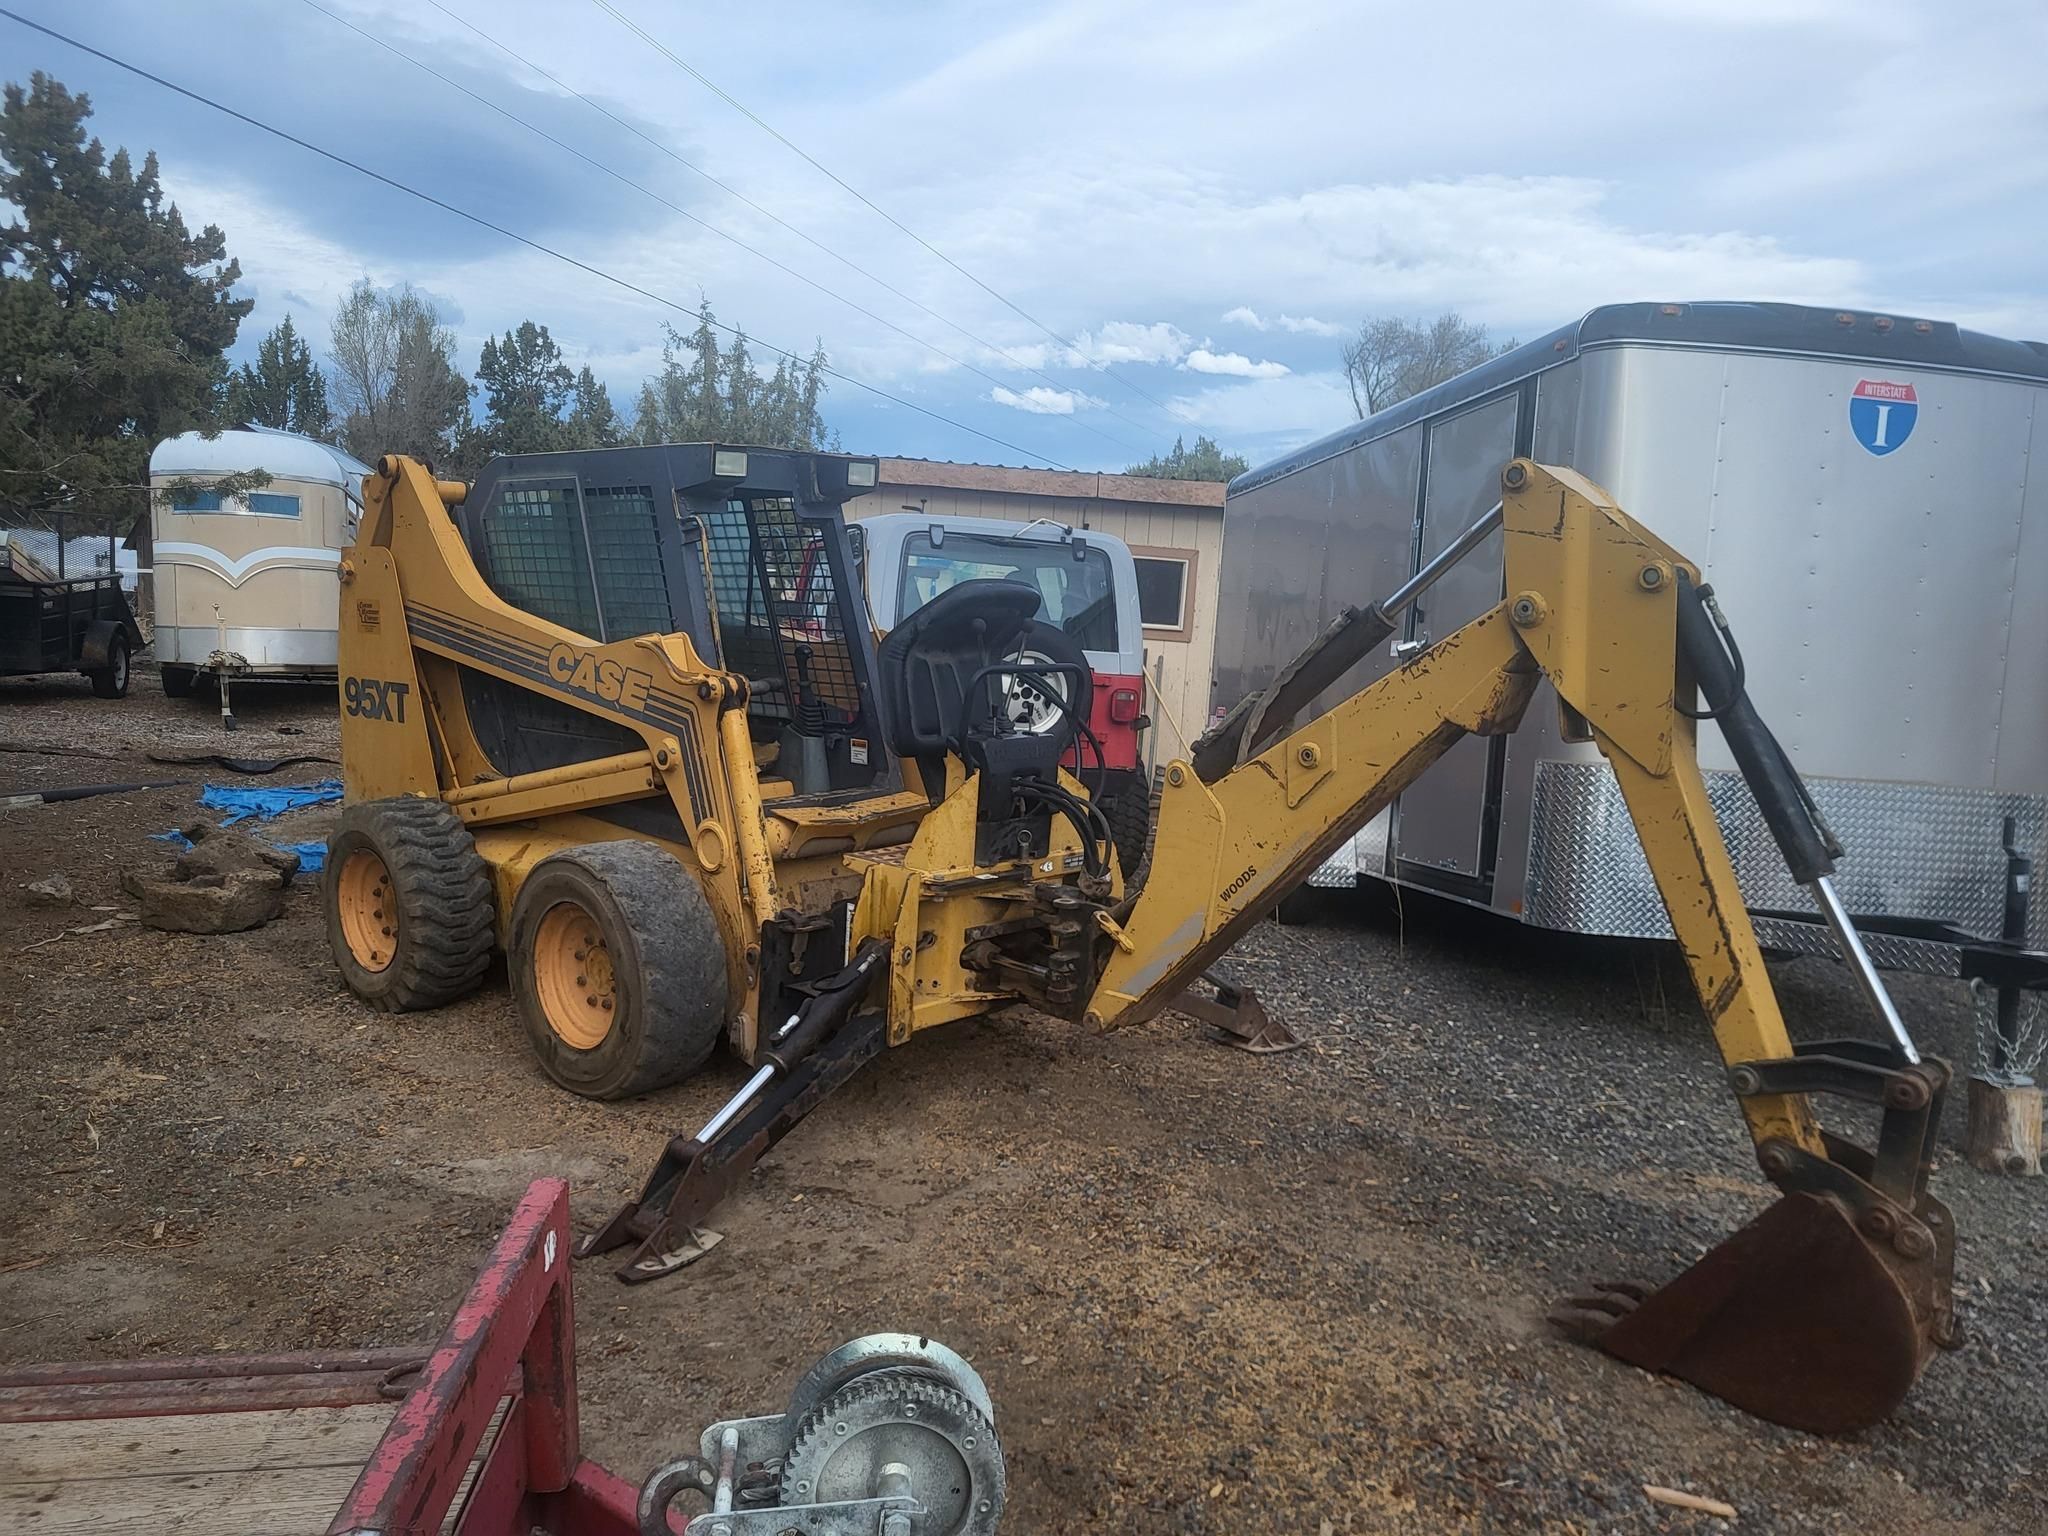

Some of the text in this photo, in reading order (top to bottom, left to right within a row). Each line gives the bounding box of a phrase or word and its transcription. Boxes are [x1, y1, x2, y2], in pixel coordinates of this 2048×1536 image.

[1864, 383, 1908, 399] INTERSTATE
[548, 642, 653, 713] CASE
[345, 676, 410, 724] 95XT
[1219, 865, 1257, 902] WOODS
